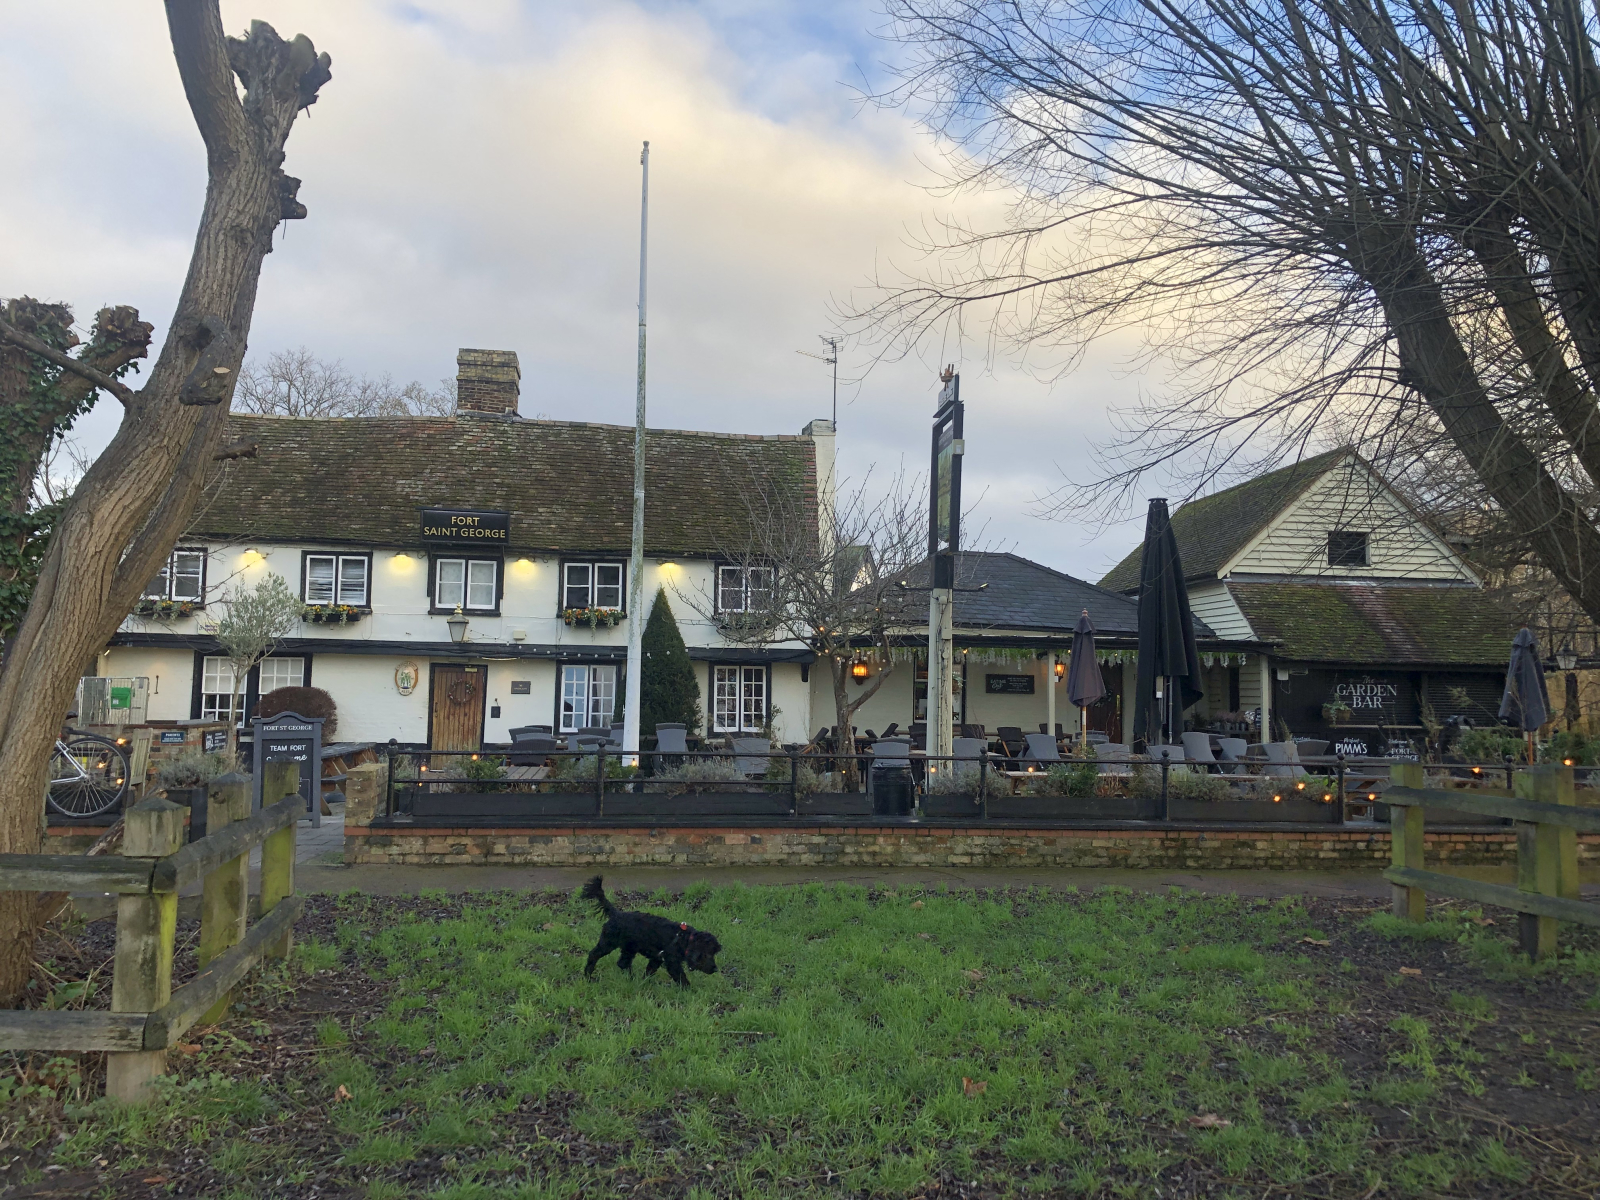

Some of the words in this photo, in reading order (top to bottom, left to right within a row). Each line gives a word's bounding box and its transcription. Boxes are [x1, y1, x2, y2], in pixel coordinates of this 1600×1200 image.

[451, 516, 480, 526] FORT
[423, 526, 458, 537] SAINT
[460, 528, 506, 538] GEORGE
[1337, 684, 1397, 696] GARDEN
[1352, 696, 1382, 707] BAR
[269, 744, 288, 752] TEAM
[289, 744, 307, 752] FORT
[1335, 742, 1368, 754] PIMM'S
